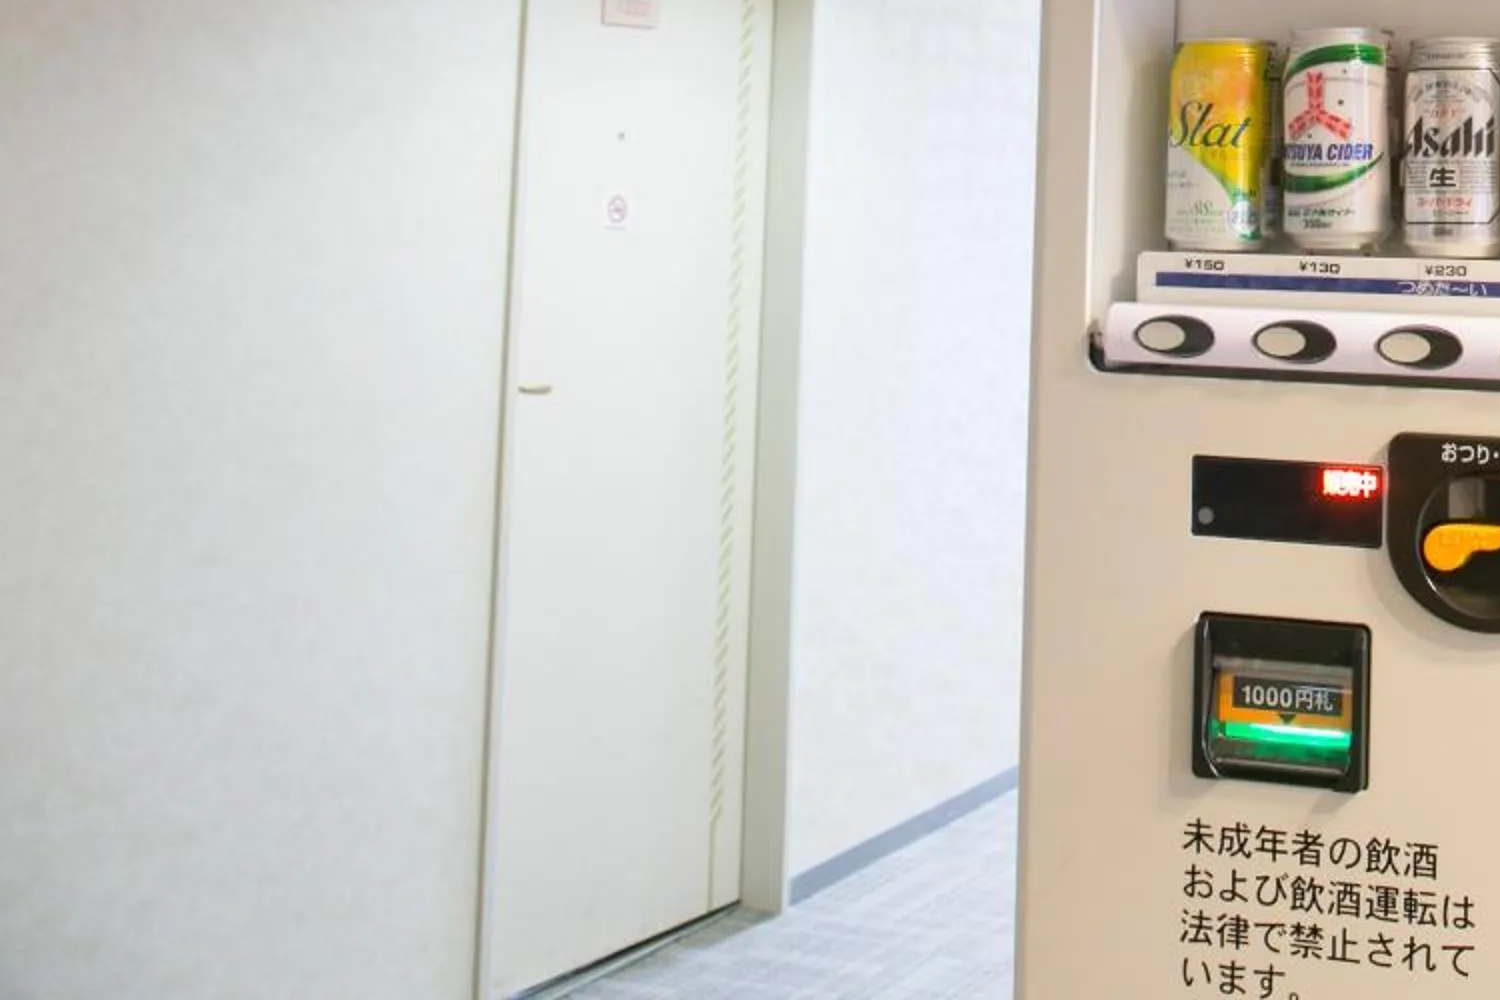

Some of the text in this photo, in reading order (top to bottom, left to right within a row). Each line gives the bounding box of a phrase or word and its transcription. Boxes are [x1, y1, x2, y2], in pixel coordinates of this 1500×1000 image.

[1174, 99, 1252, 148] Slat
[1401, 115, 1495, 159] Asahi
[1327, 143, 1374, 161] CIDER
[1429, 166, 1456, 188] 生
[1185, 258, 1225, 271] ¥150
[1299, 261, 1340, 274] ¥130
[1425, 264, 1467, 277] ¥230
[1241, 685, 1334, 712] 1000円札
[1182, 817, 1439, 880] 未成年者の飲酒
[1183, 864, 1476, 929] および飲酒運転は
[1180, 909, 1476, 979] 法律で禁止されて
